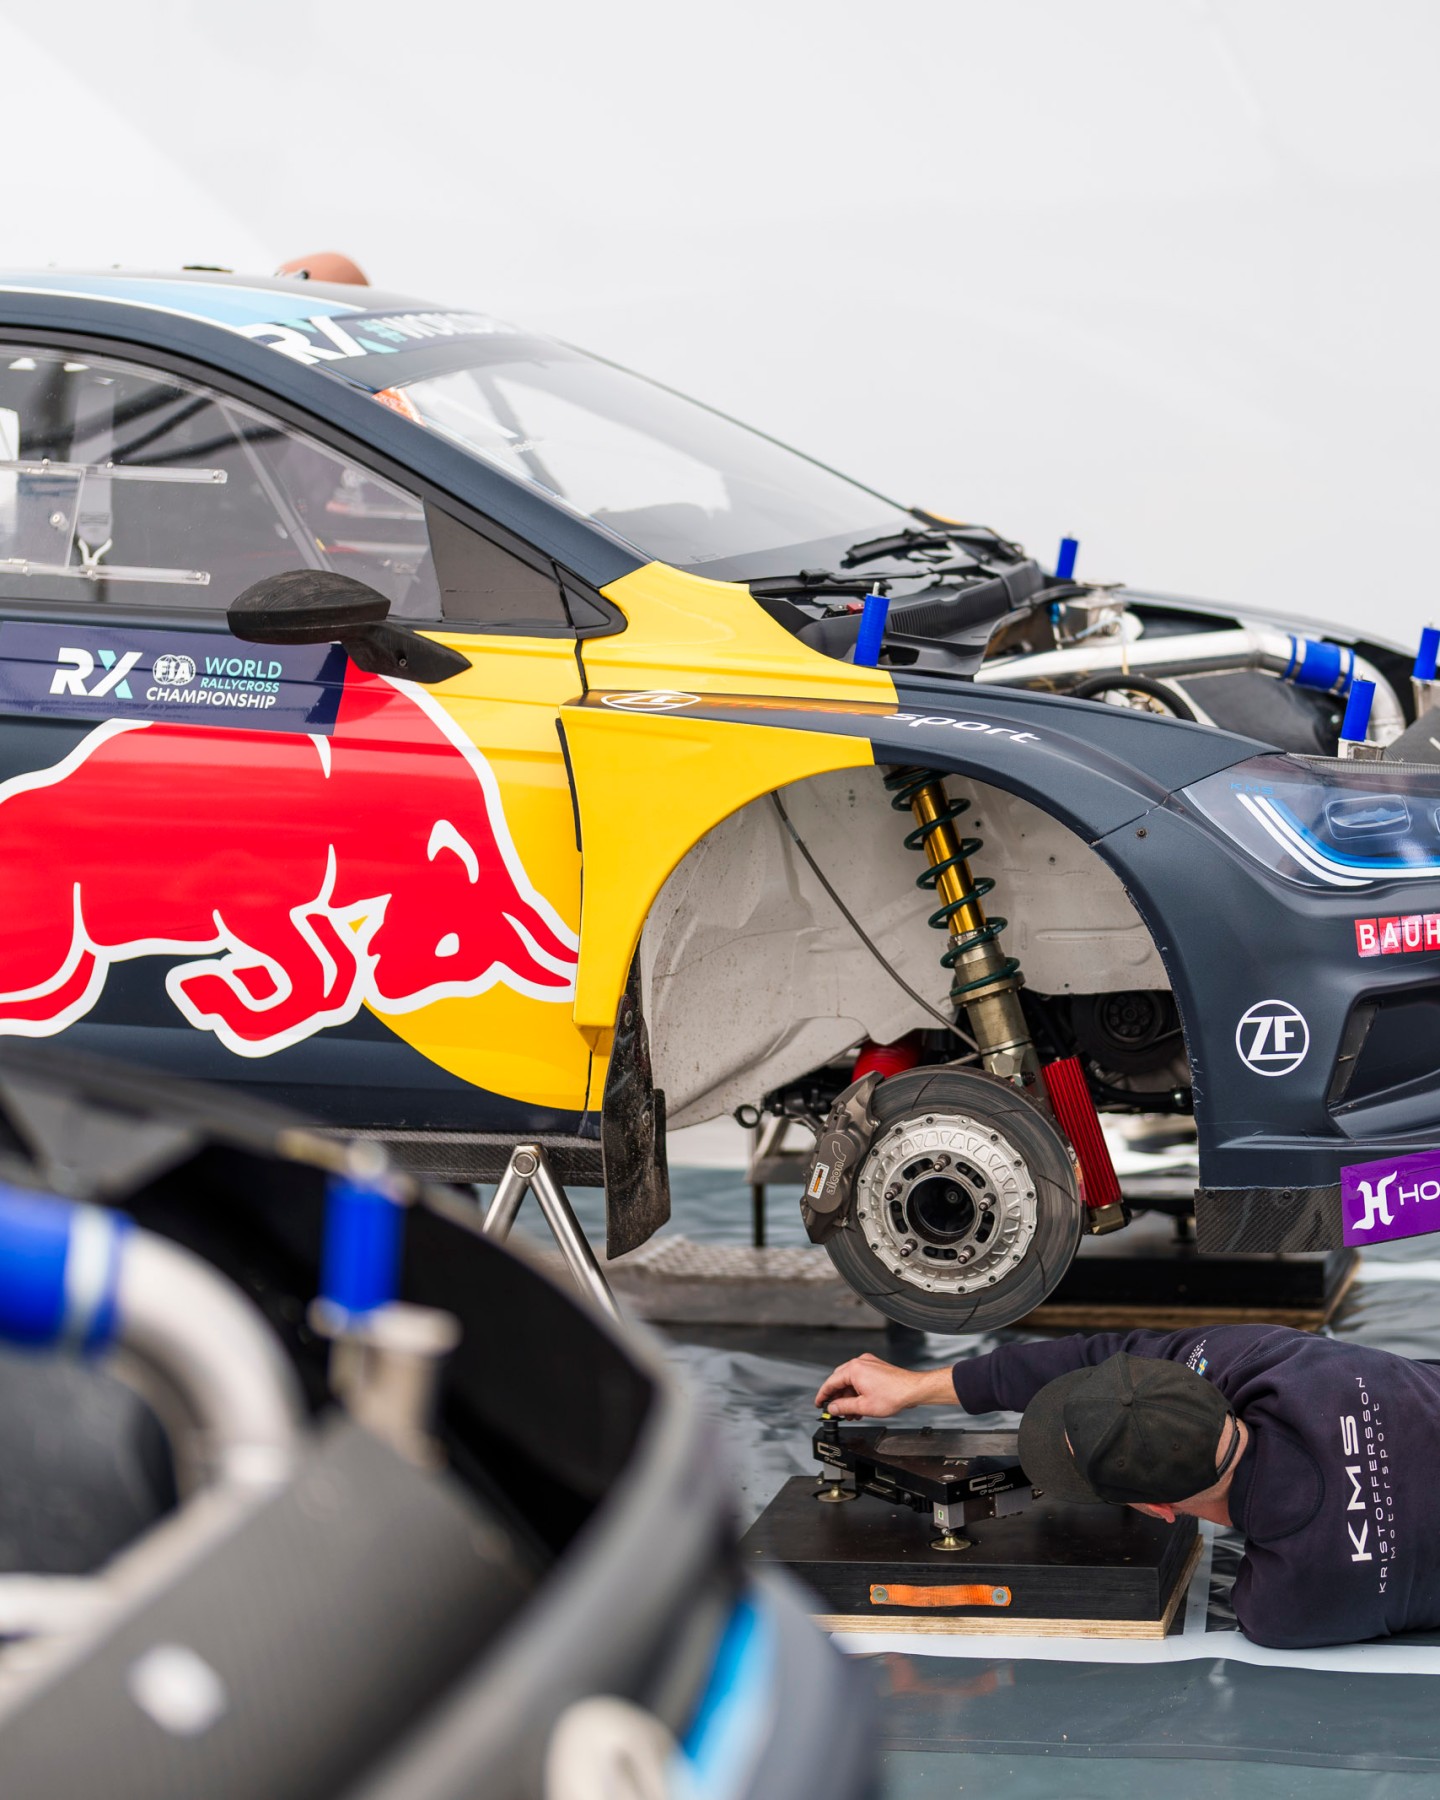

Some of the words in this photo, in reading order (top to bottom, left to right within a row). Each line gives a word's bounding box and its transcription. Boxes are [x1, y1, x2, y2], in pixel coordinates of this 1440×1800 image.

[50, 647, 143, 699] RX
[155, 660, 191, 680] FIA
[205, 656, 283, 679] WORLD
[146, 687, 277, 709] CHAMPIONSHIP
[200, 676, 280, 694] RALLYCROSS
[883, 711, 1041, 744] sport
[1229, 782, 1276, 796] KMS
[1358, 914, 1440, 951] BAUH
[1241, 1014, 1303, 1061] ZF
[826, 1161, 845, 1196] alcon
[1339, 1414, 1373, 1562] KMS
[1355, 1377, 1389, 1594] KRISTOFFERSSON
